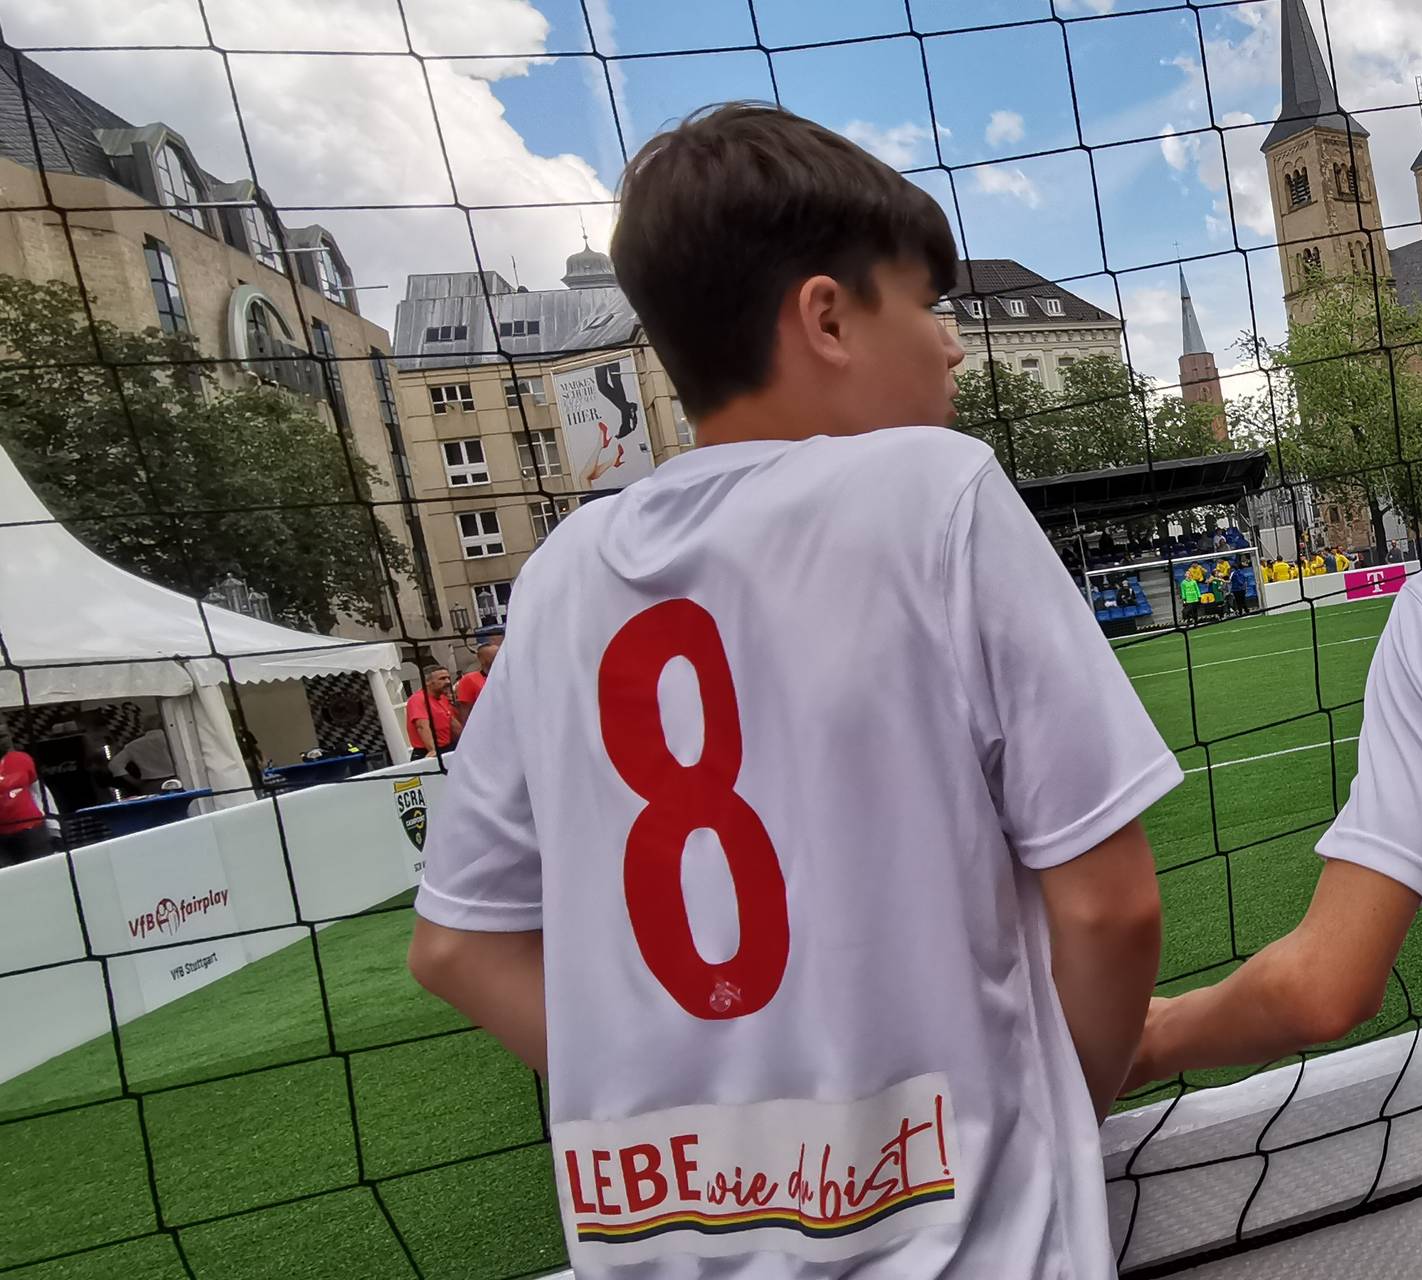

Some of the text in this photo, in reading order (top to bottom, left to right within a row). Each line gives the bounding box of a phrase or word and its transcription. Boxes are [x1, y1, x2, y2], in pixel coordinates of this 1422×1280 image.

[1366, 571, 1385, 593] T
[397, 789, 426, 814] SCRA
[598, 597, 791, 1020] 8
[128, 889, 229, 939] VfB fairplay
[184, 952, 219, 975] Stuttgart
[564, 1133, 702, 1217] LEBE
[706, 1165, 779, 1207] wie
[787, 1141, 814, 1211] du
